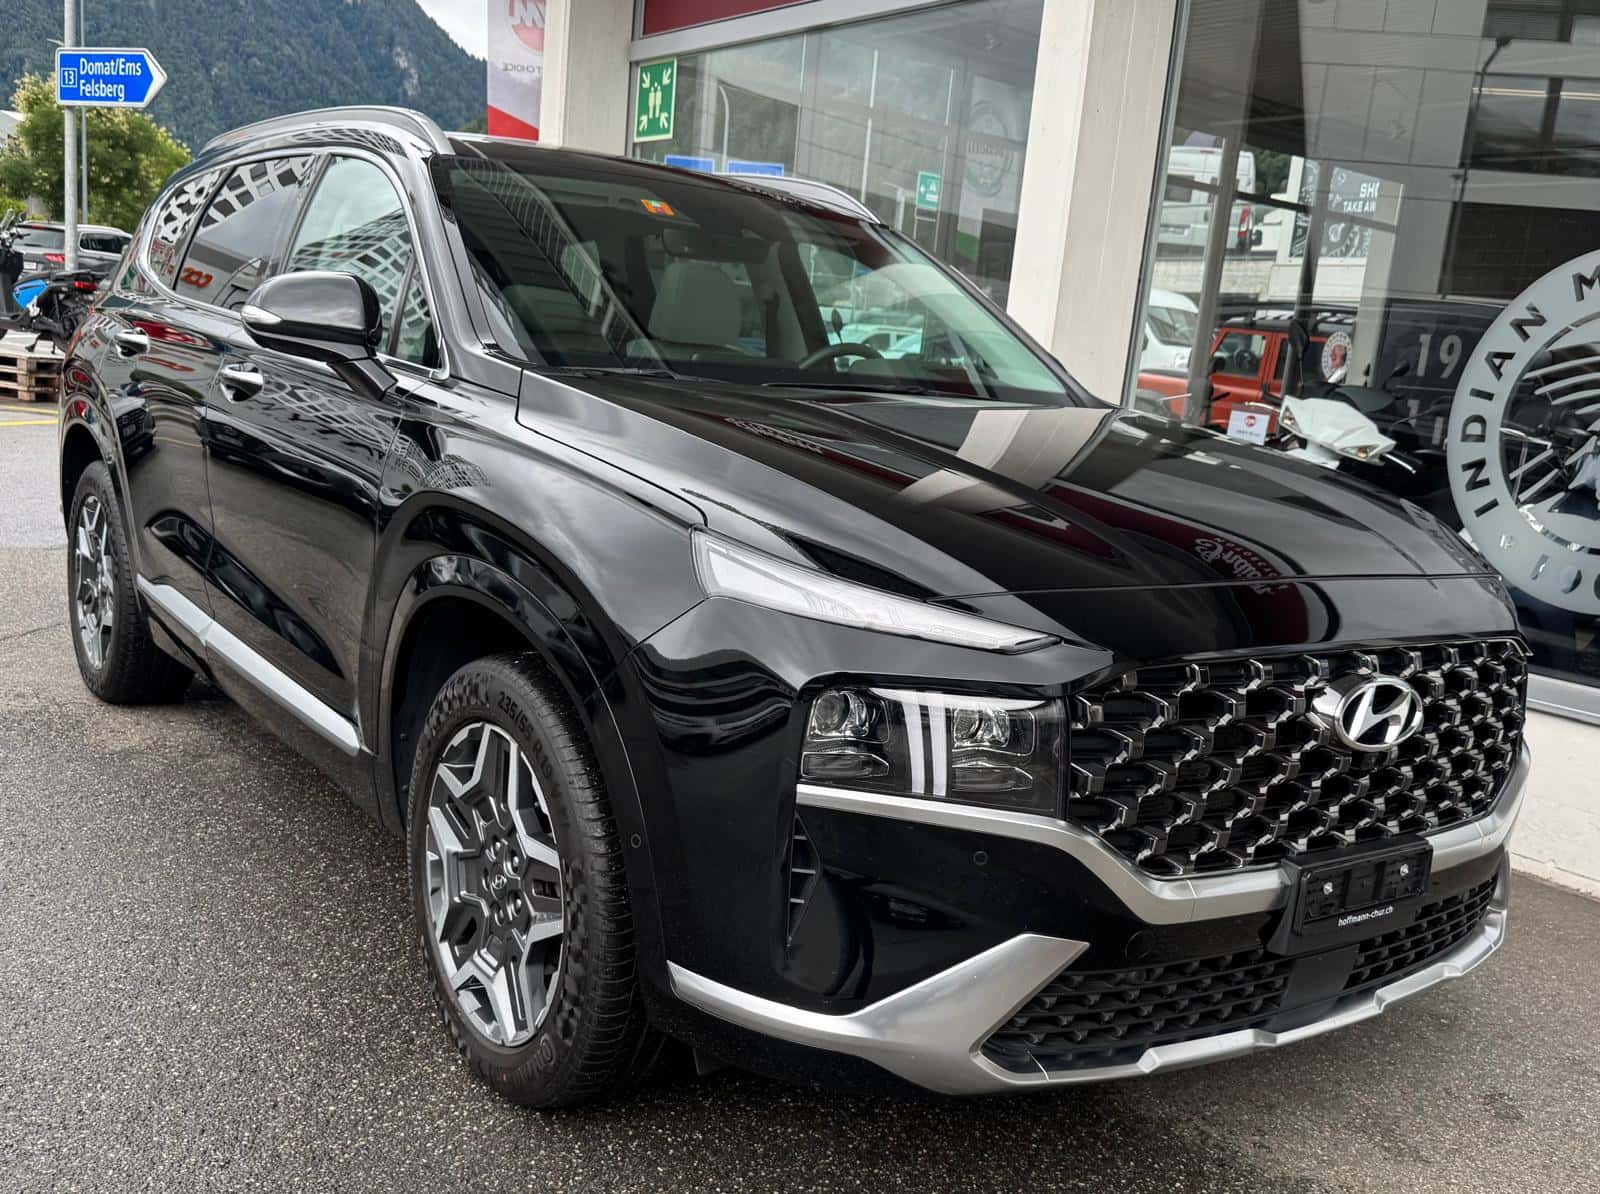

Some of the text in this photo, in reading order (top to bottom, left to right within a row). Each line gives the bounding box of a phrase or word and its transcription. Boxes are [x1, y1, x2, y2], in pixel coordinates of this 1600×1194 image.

[80, 57, 142, 76] Domat/Ems
[64, 70, 75, 85] 13
[80, 79, 125, 102] Felsberg
[1343, 200, 1363, 213] TAKE
[1460, 302, 1548, 518] INDIAN
[1337, 905, 1394, 927] hoffmann-chur.ch
